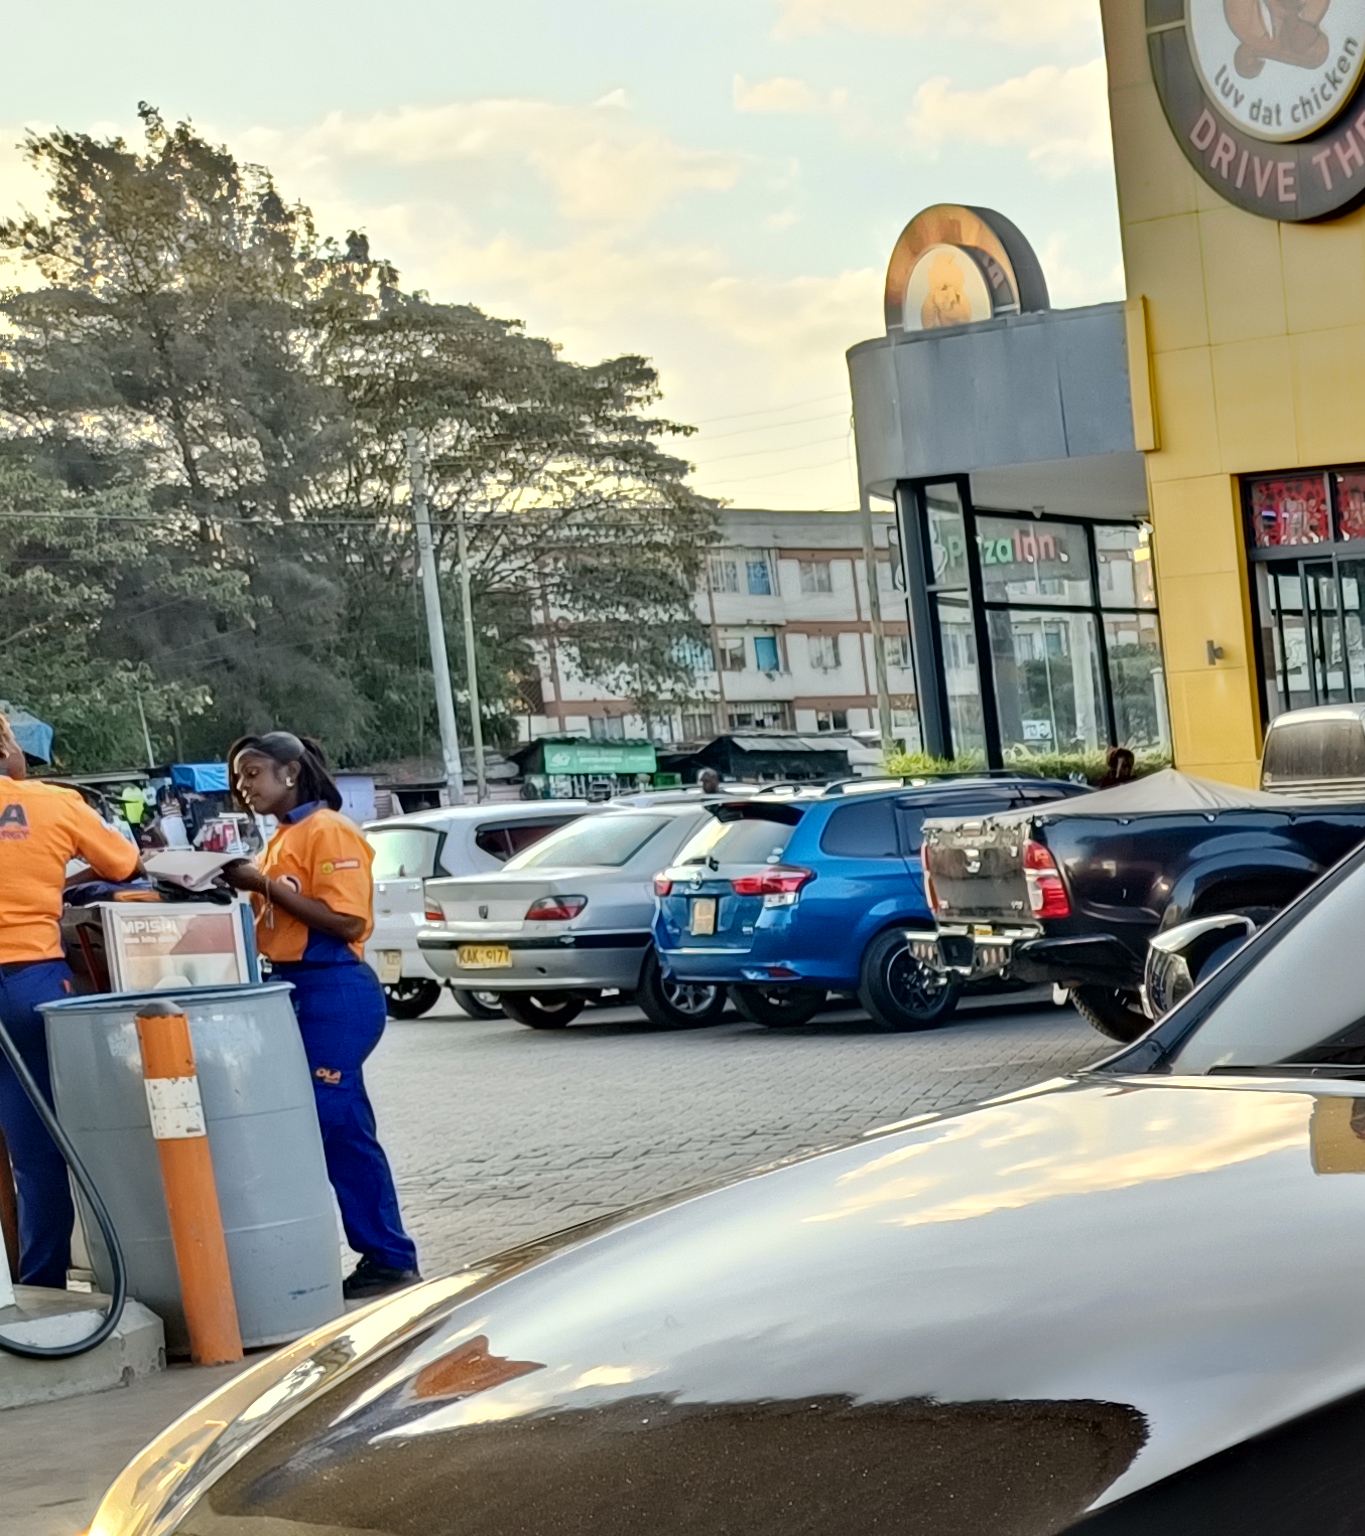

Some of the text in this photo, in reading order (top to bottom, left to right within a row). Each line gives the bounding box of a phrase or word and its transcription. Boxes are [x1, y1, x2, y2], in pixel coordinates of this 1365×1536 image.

[1214, 36, 1359, 127] luv dat chicken
[1189, 108, 1297, 203] DRIVE
